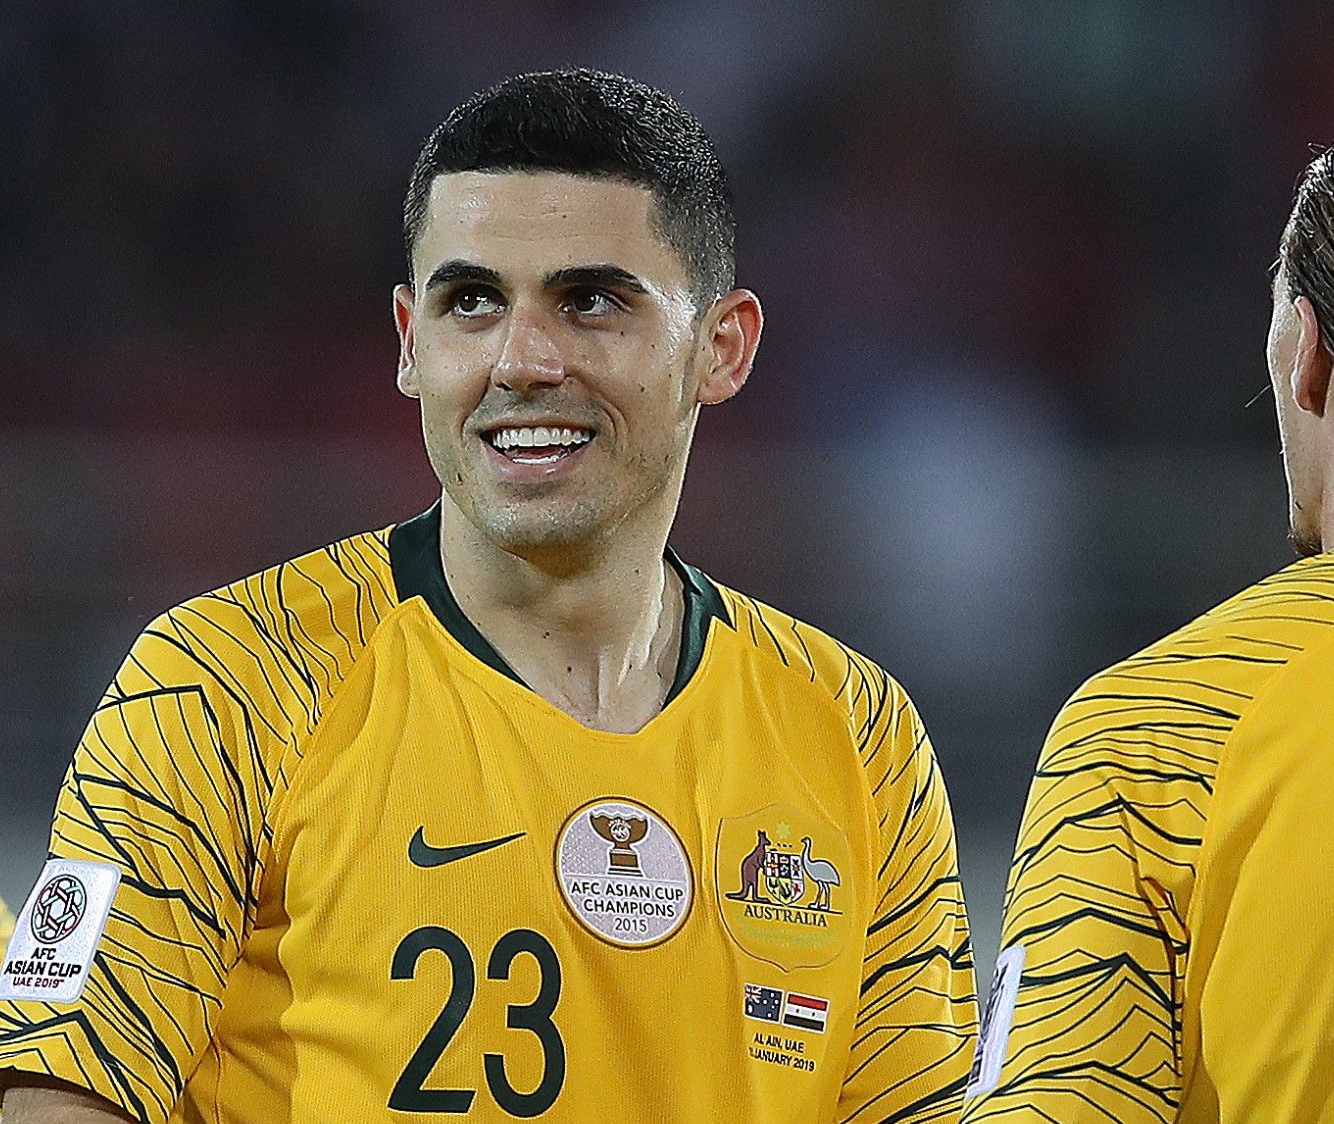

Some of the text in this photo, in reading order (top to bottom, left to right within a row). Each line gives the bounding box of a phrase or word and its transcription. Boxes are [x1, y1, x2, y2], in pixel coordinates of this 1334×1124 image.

[571, 881, 684, 901] AFC ASIAN CUP
[583, 898, 675, 917] CHAMPIONS
[744, 904, 827, 927] AUSTRALIA
[614, 917, 647, 932] 2015
[31, 947, 57, 960] AFC
[4, 961, 82, 977] ASIAN CUP
[13, 976, 33, 987] UAE
[387, 926, 566, 1118] 23
[785, 1039, 805, 1053] UAE
[793, 1057, 815, 1072] 2019
